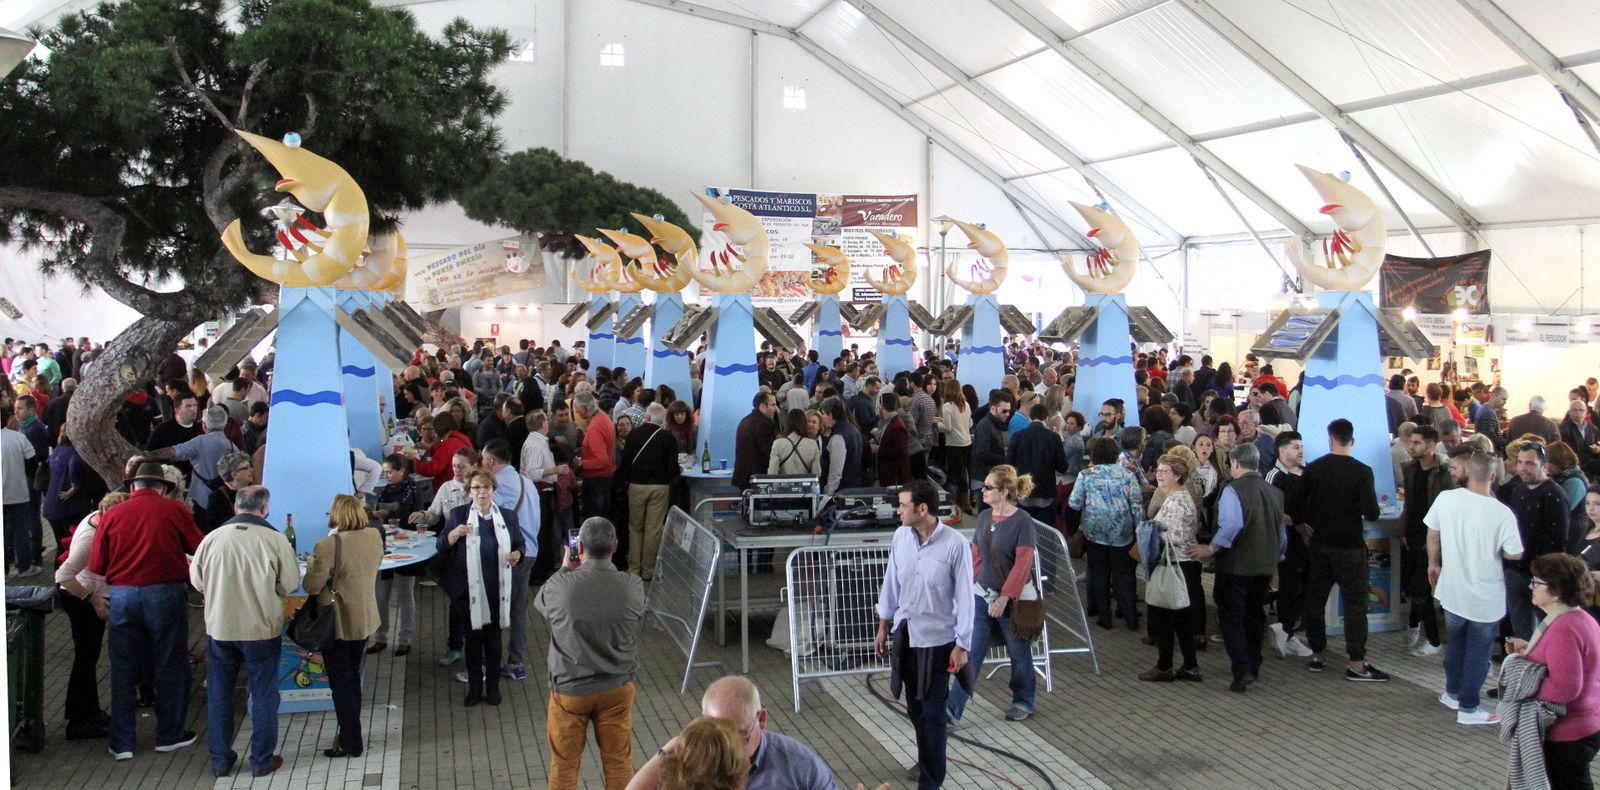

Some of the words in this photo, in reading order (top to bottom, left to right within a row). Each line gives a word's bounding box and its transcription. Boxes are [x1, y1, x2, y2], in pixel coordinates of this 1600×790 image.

[733, 195, 768, 204] PESCADOS
[776, 198, 812, 206] MARISCOS
[759, 203, 800, 213] ATLÁNTICO
[857, 209, 903, 222] Varadero
[427, 253, 457, 271] PESCADO
[458, 248, 471, 257] DEL
[473, 243, 486, 252] DÍA
[431, 263, 454, 278] PUNTA
[1545, 334, 1567, 343] PESCADOR
